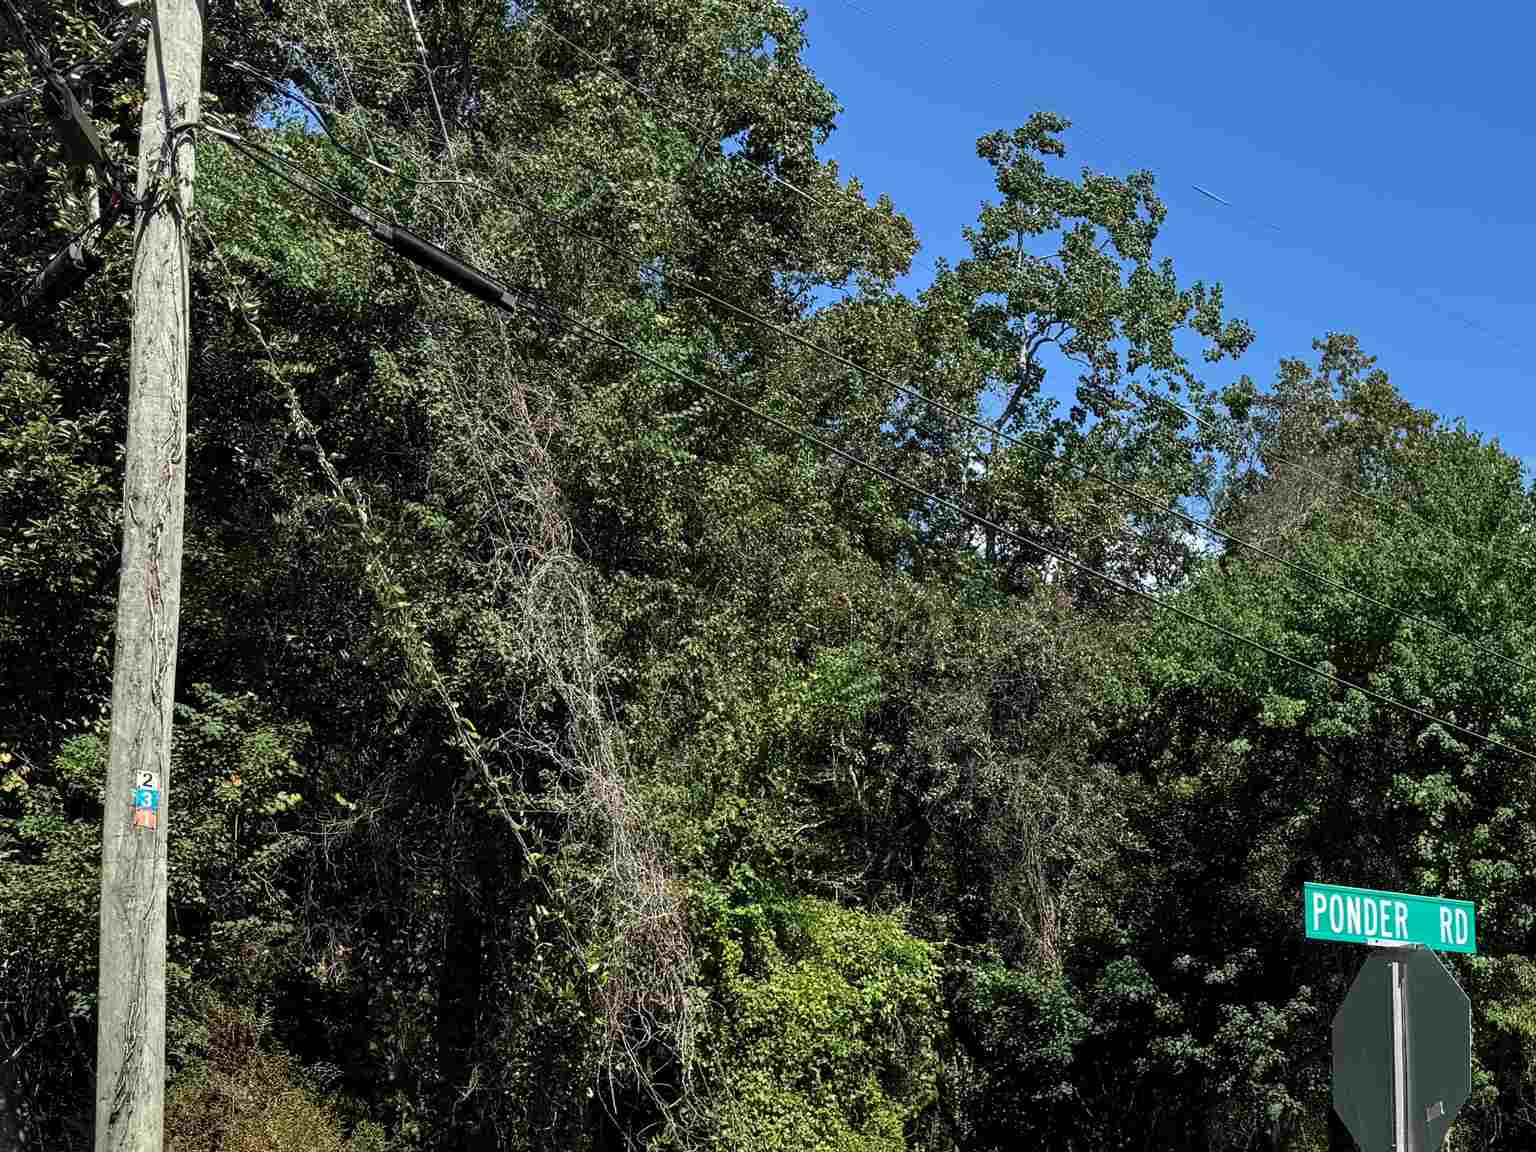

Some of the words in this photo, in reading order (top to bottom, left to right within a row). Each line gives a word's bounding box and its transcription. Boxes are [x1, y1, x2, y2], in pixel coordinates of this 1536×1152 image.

[142, 773, 153, 788] 2
[143, 792, 153, 807] 3
[1312, 892, 1408, 939] PONDER
[1439, 905, 1468, 945] RD
